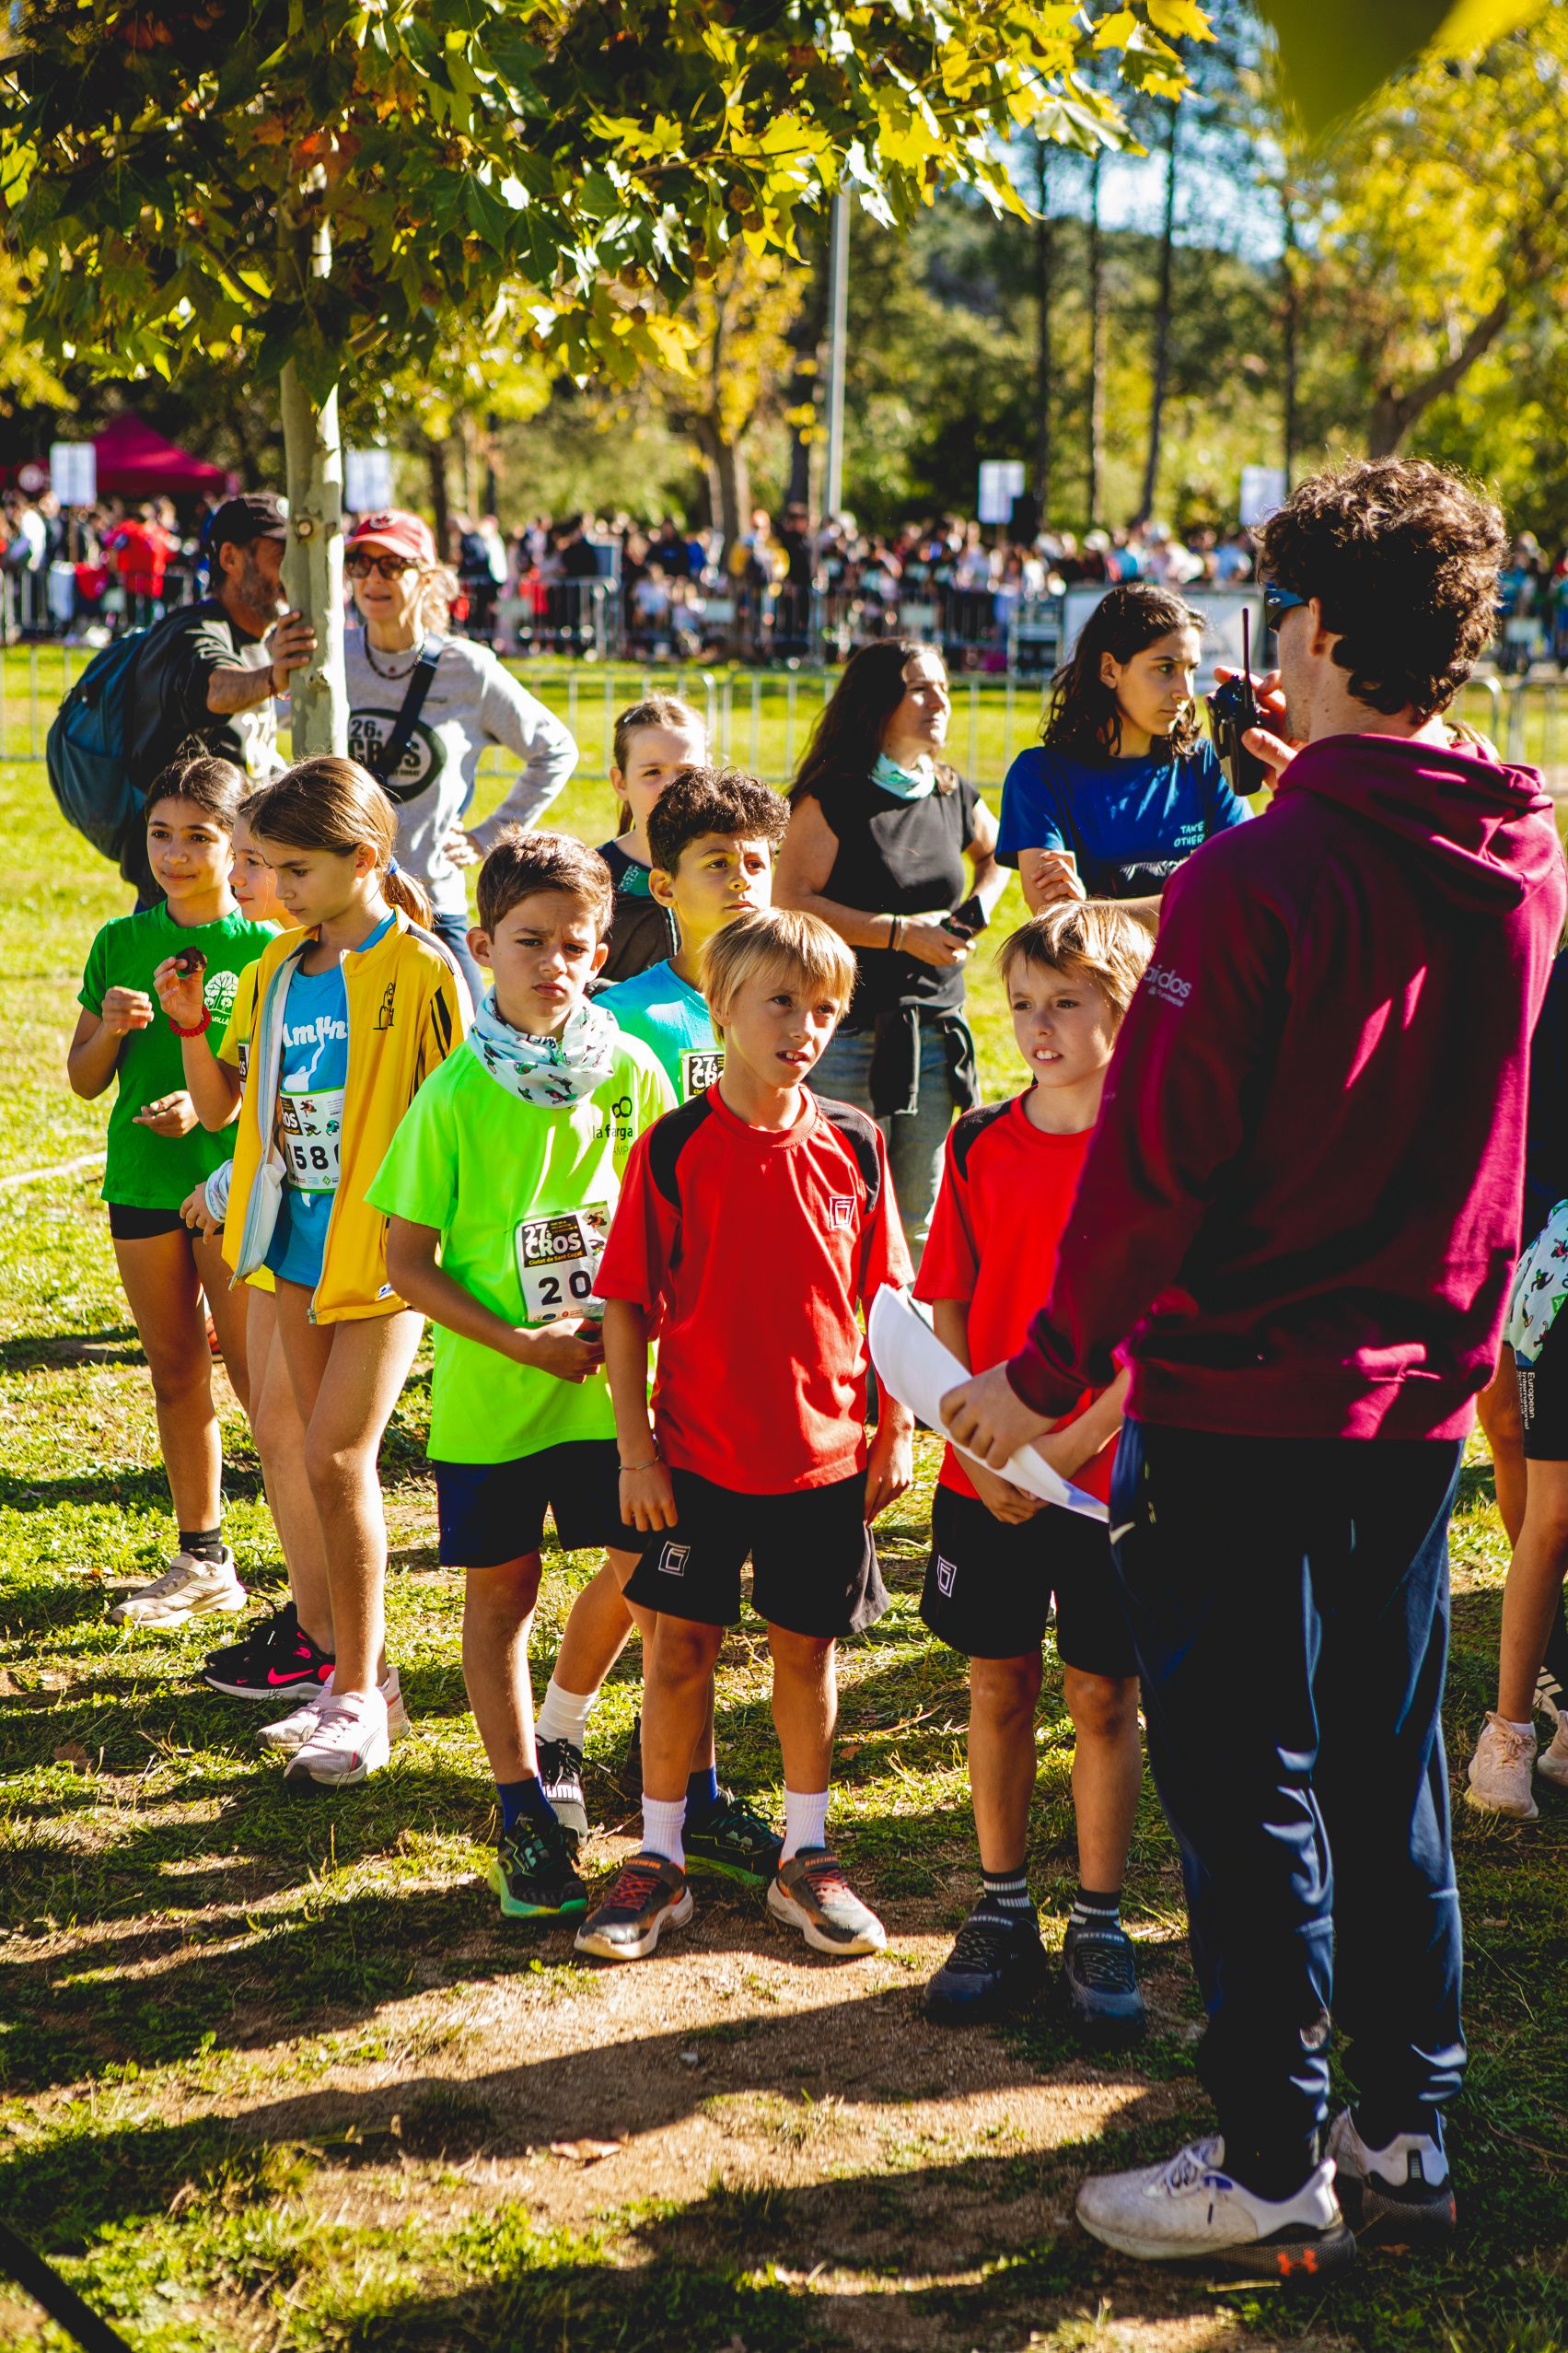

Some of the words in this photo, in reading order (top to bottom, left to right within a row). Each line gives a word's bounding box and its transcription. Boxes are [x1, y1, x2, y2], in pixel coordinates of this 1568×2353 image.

[1180, 821, 1204, 834] TAKE
[1174, 833, 1204, 847] OTHER
[525, 1232, 582, 1259] CROS
[528, 1256, 546, 1266] Ciutat
[554, 1252, 567, 1262] Sant
[1522, 1371, 1530, 1430] International
[1527, 1371, 1536, 1419] European
